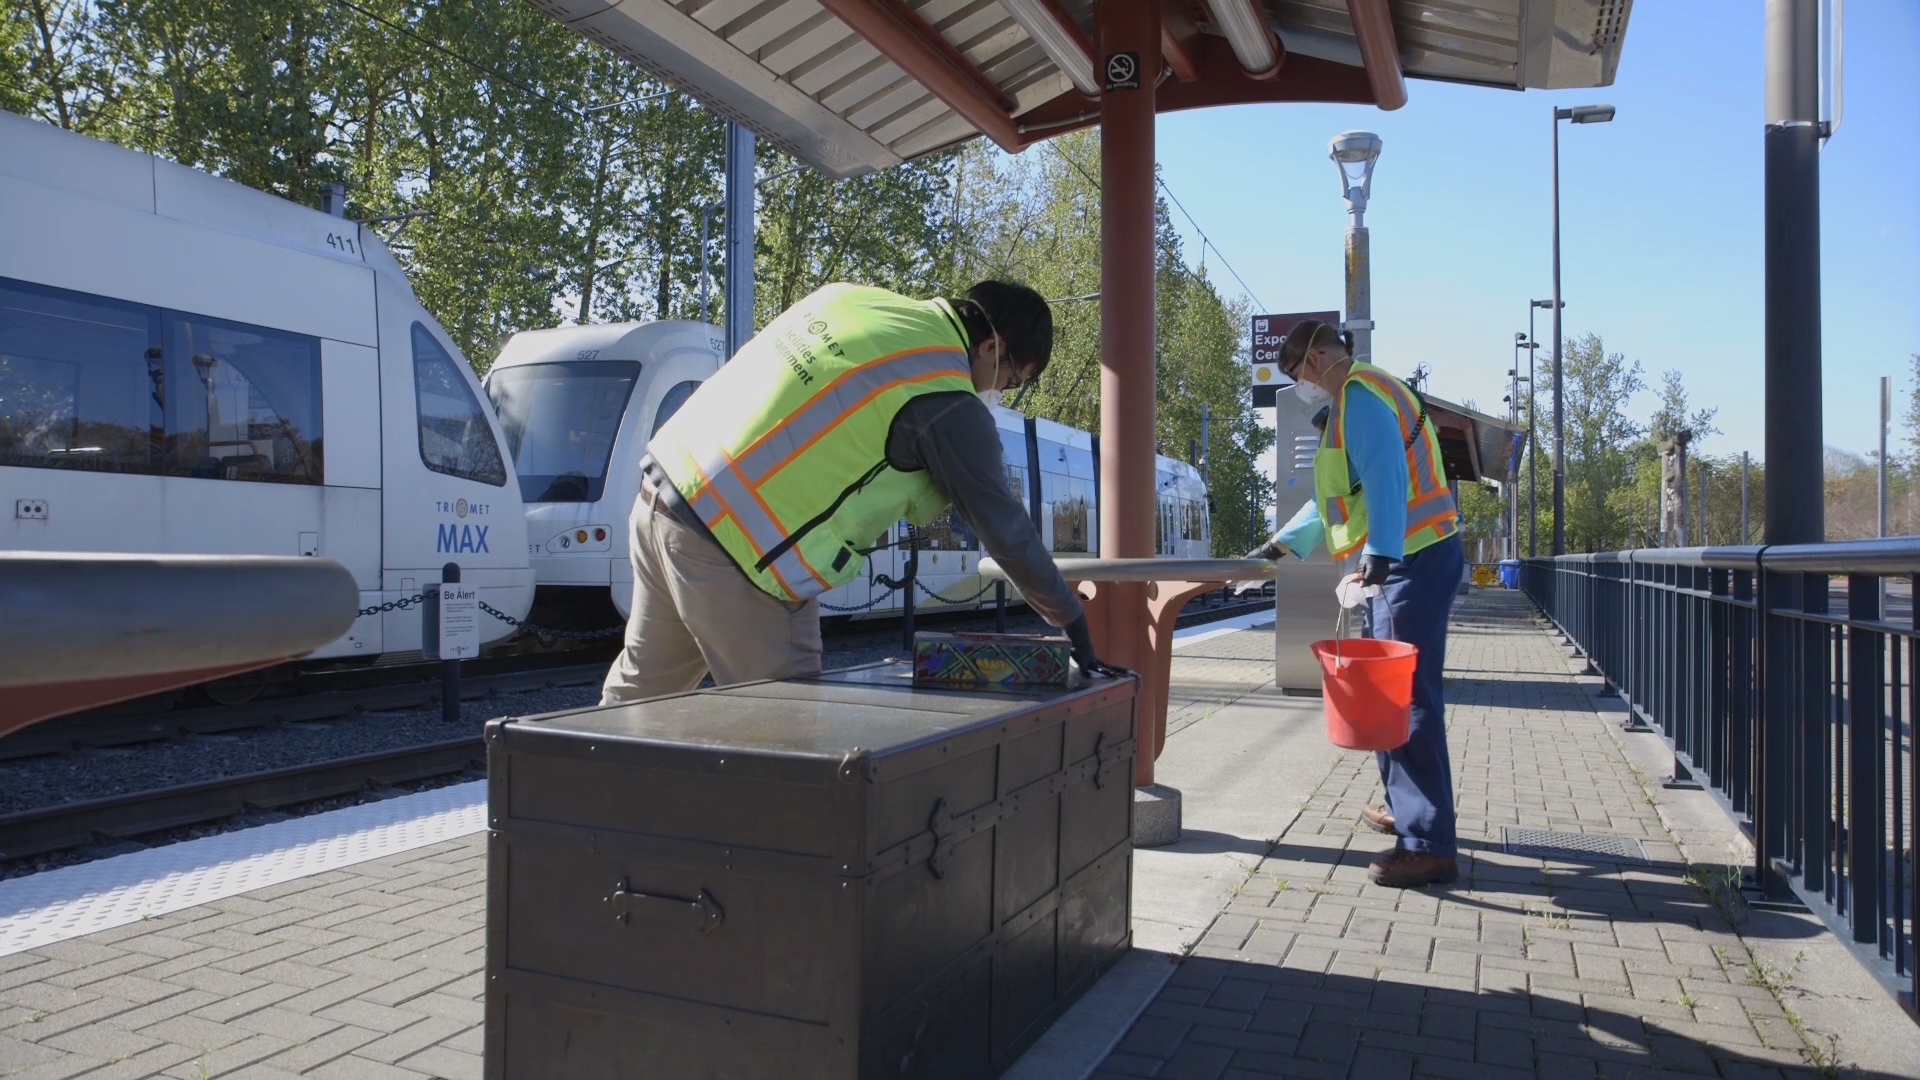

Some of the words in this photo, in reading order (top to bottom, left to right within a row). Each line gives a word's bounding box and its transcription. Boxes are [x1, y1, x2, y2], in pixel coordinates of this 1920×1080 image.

[326, 232, 355, 254] 411
[710, 337, 725, 351] 527
[785, 326, 816, 364] acilities
[820, 332, 845, 358] MET
[577, 350, 600, 361] 527
[773, 337, 814, 386] nagement
[1255, 349, 1279, 360] Cen
[436, 501, 454, 513] TRI
[470, 503, 490, 515] MET
[436, 523, 490, 554] MAX
[444, 590, 454, 600] Be
[456, 590, 475, 600] Alert
